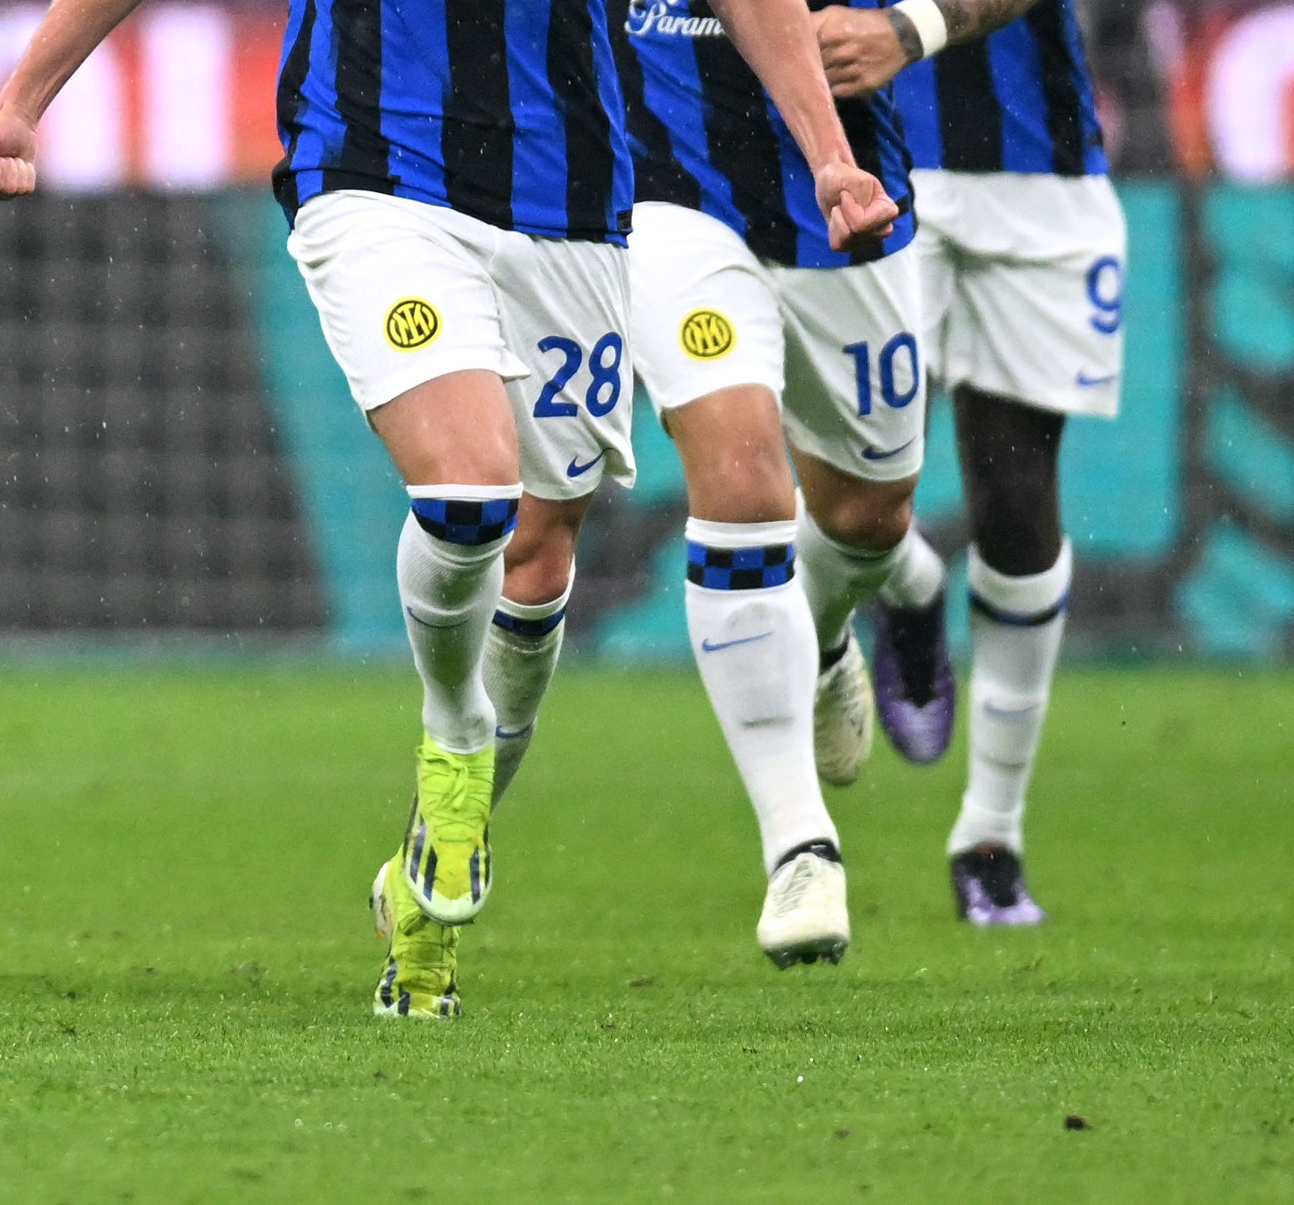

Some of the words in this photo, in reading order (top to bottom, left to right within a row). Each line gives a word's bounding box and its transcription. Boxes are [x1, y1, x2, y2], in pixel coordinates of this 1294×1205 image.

[1085, 255, 1124, 336] 9
[533, 332, 624, 419] 28
[843, 331, 921, 417] 10
